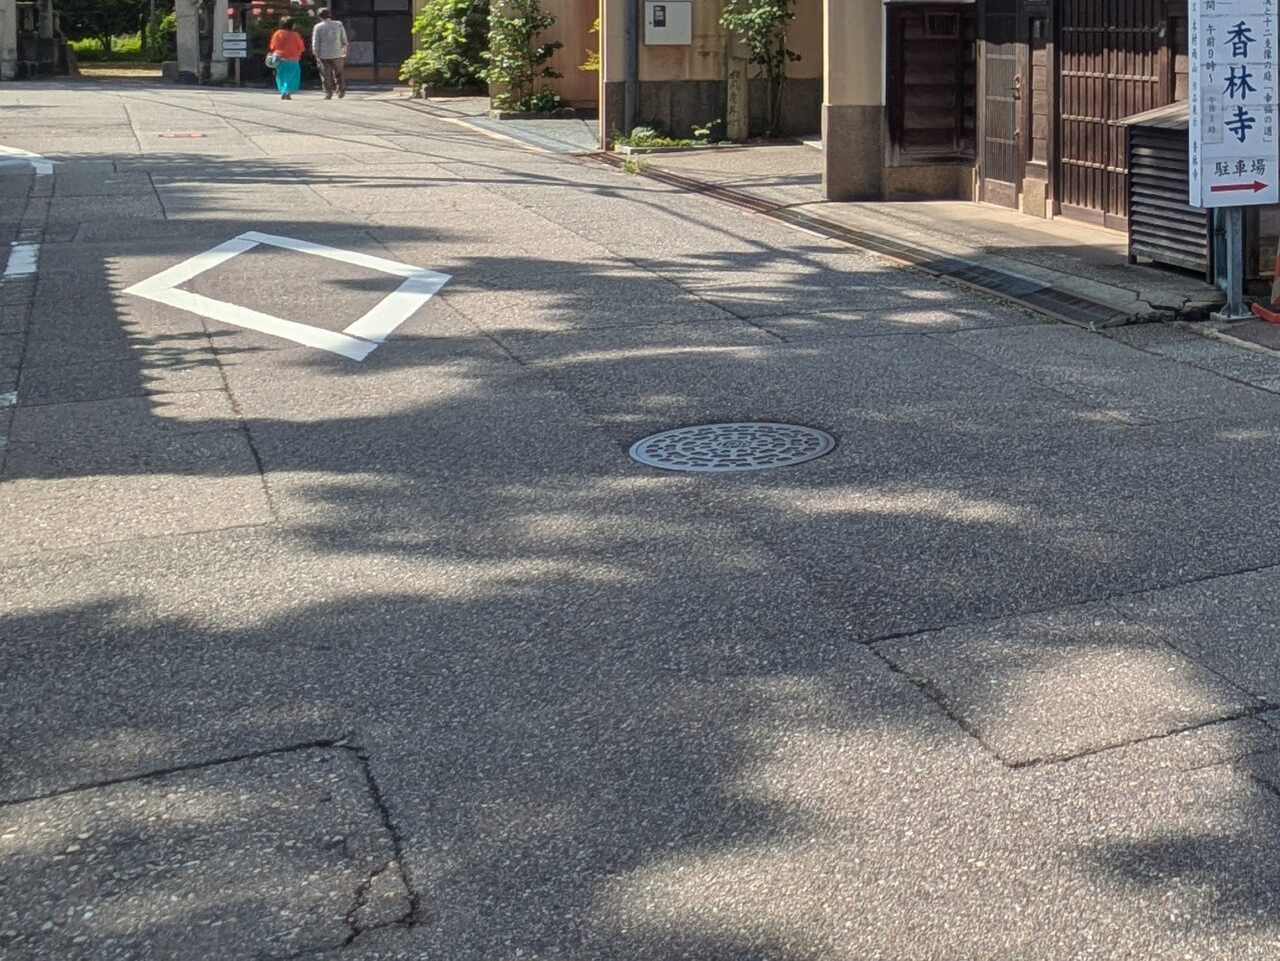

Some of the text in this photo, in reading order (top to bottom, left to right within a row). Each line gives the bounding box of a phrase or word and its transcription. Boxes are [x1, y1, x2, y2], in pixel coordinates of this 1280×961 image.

[1222, 20, 1257, 143] 香林寺
[1214, 159, 1266, 176] 駐車場
